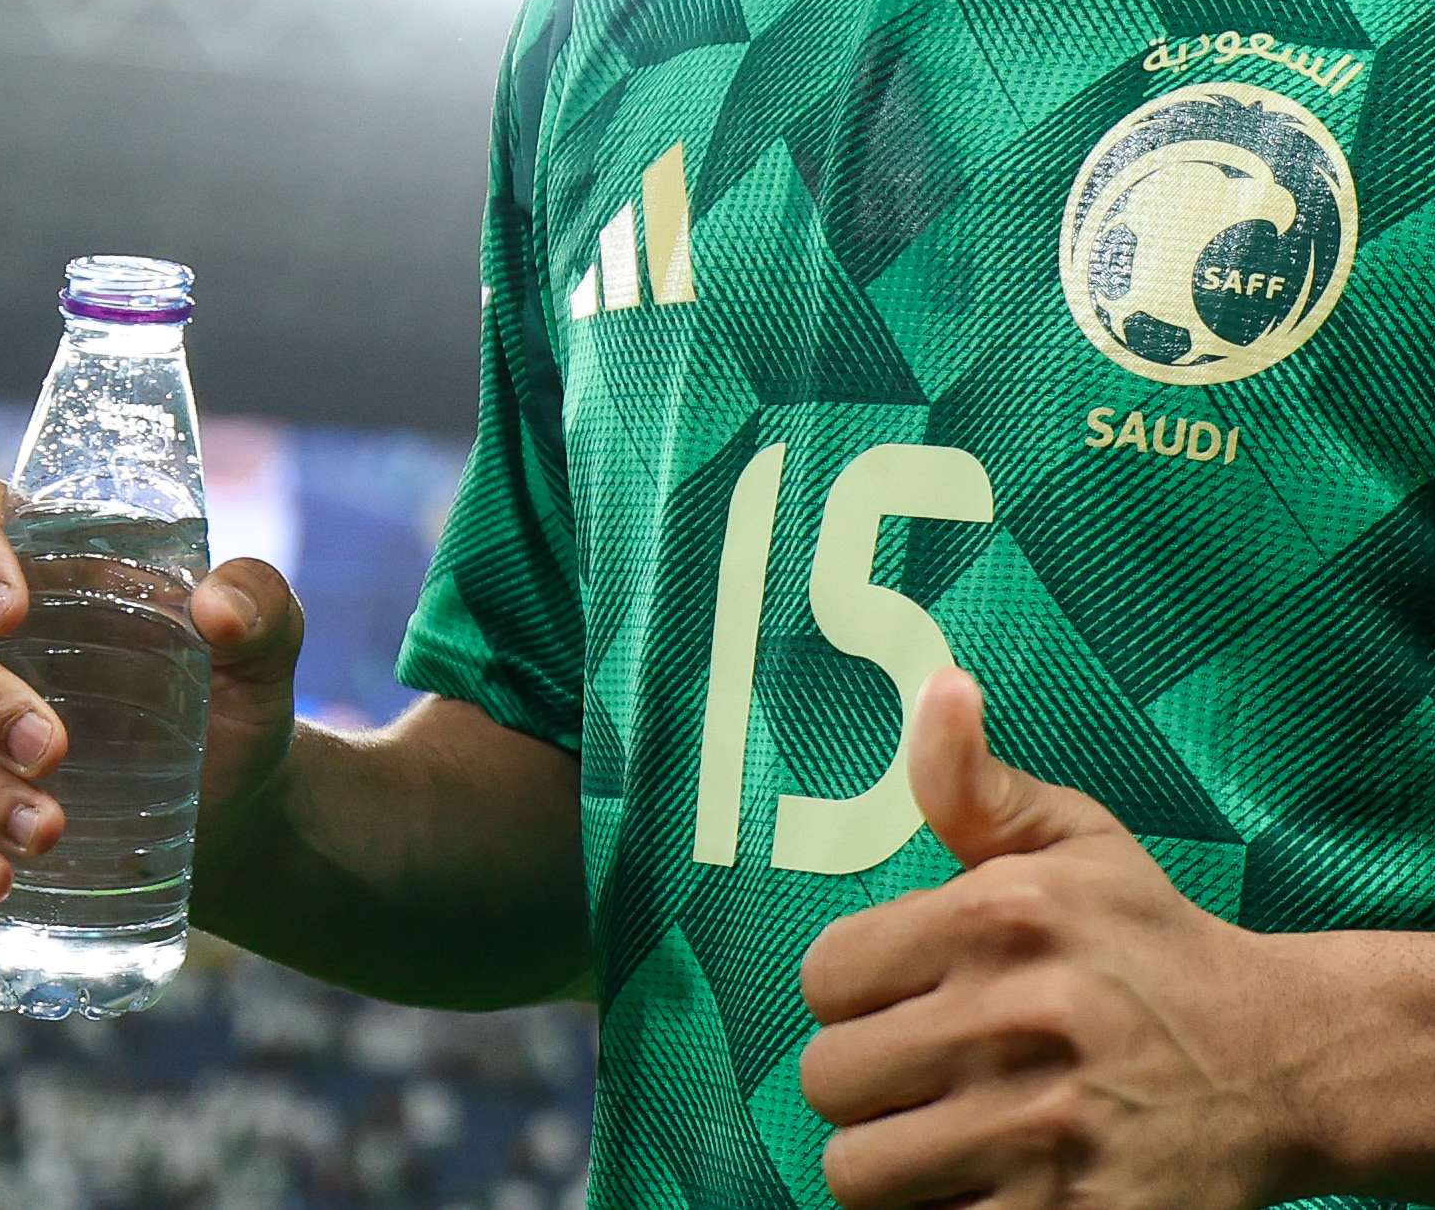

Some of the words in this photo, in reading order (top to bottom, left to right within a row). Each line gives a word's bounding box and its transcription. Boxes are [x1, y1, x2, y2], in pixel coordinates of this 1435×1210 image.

[1143, 30, 1364, 95] السعودية
[1203, 268, 1285, 299] SAFF
[1085, 407, 1241, 465] SAUDI
[693, 442, 993, 875] 15
